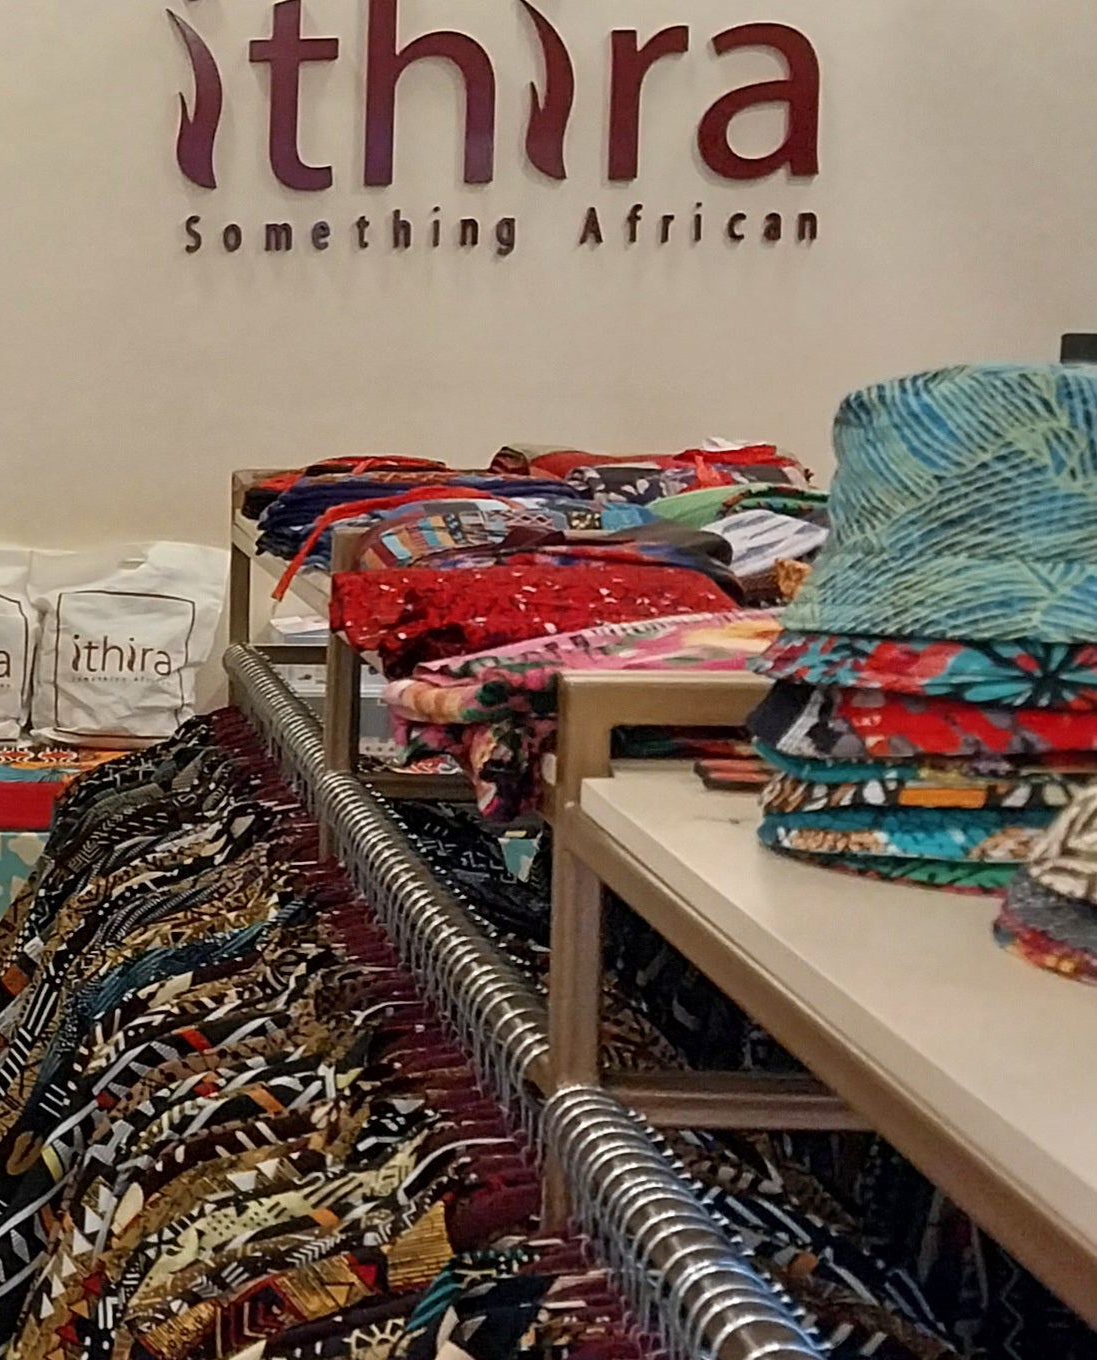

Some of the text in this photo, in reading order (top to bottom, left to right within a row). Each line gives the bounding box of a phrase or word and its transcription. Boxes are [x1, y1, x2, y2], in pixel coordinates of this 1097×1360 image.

[184, 201, 821, 256] Something African
[71, 633, 172, 676] ithira
